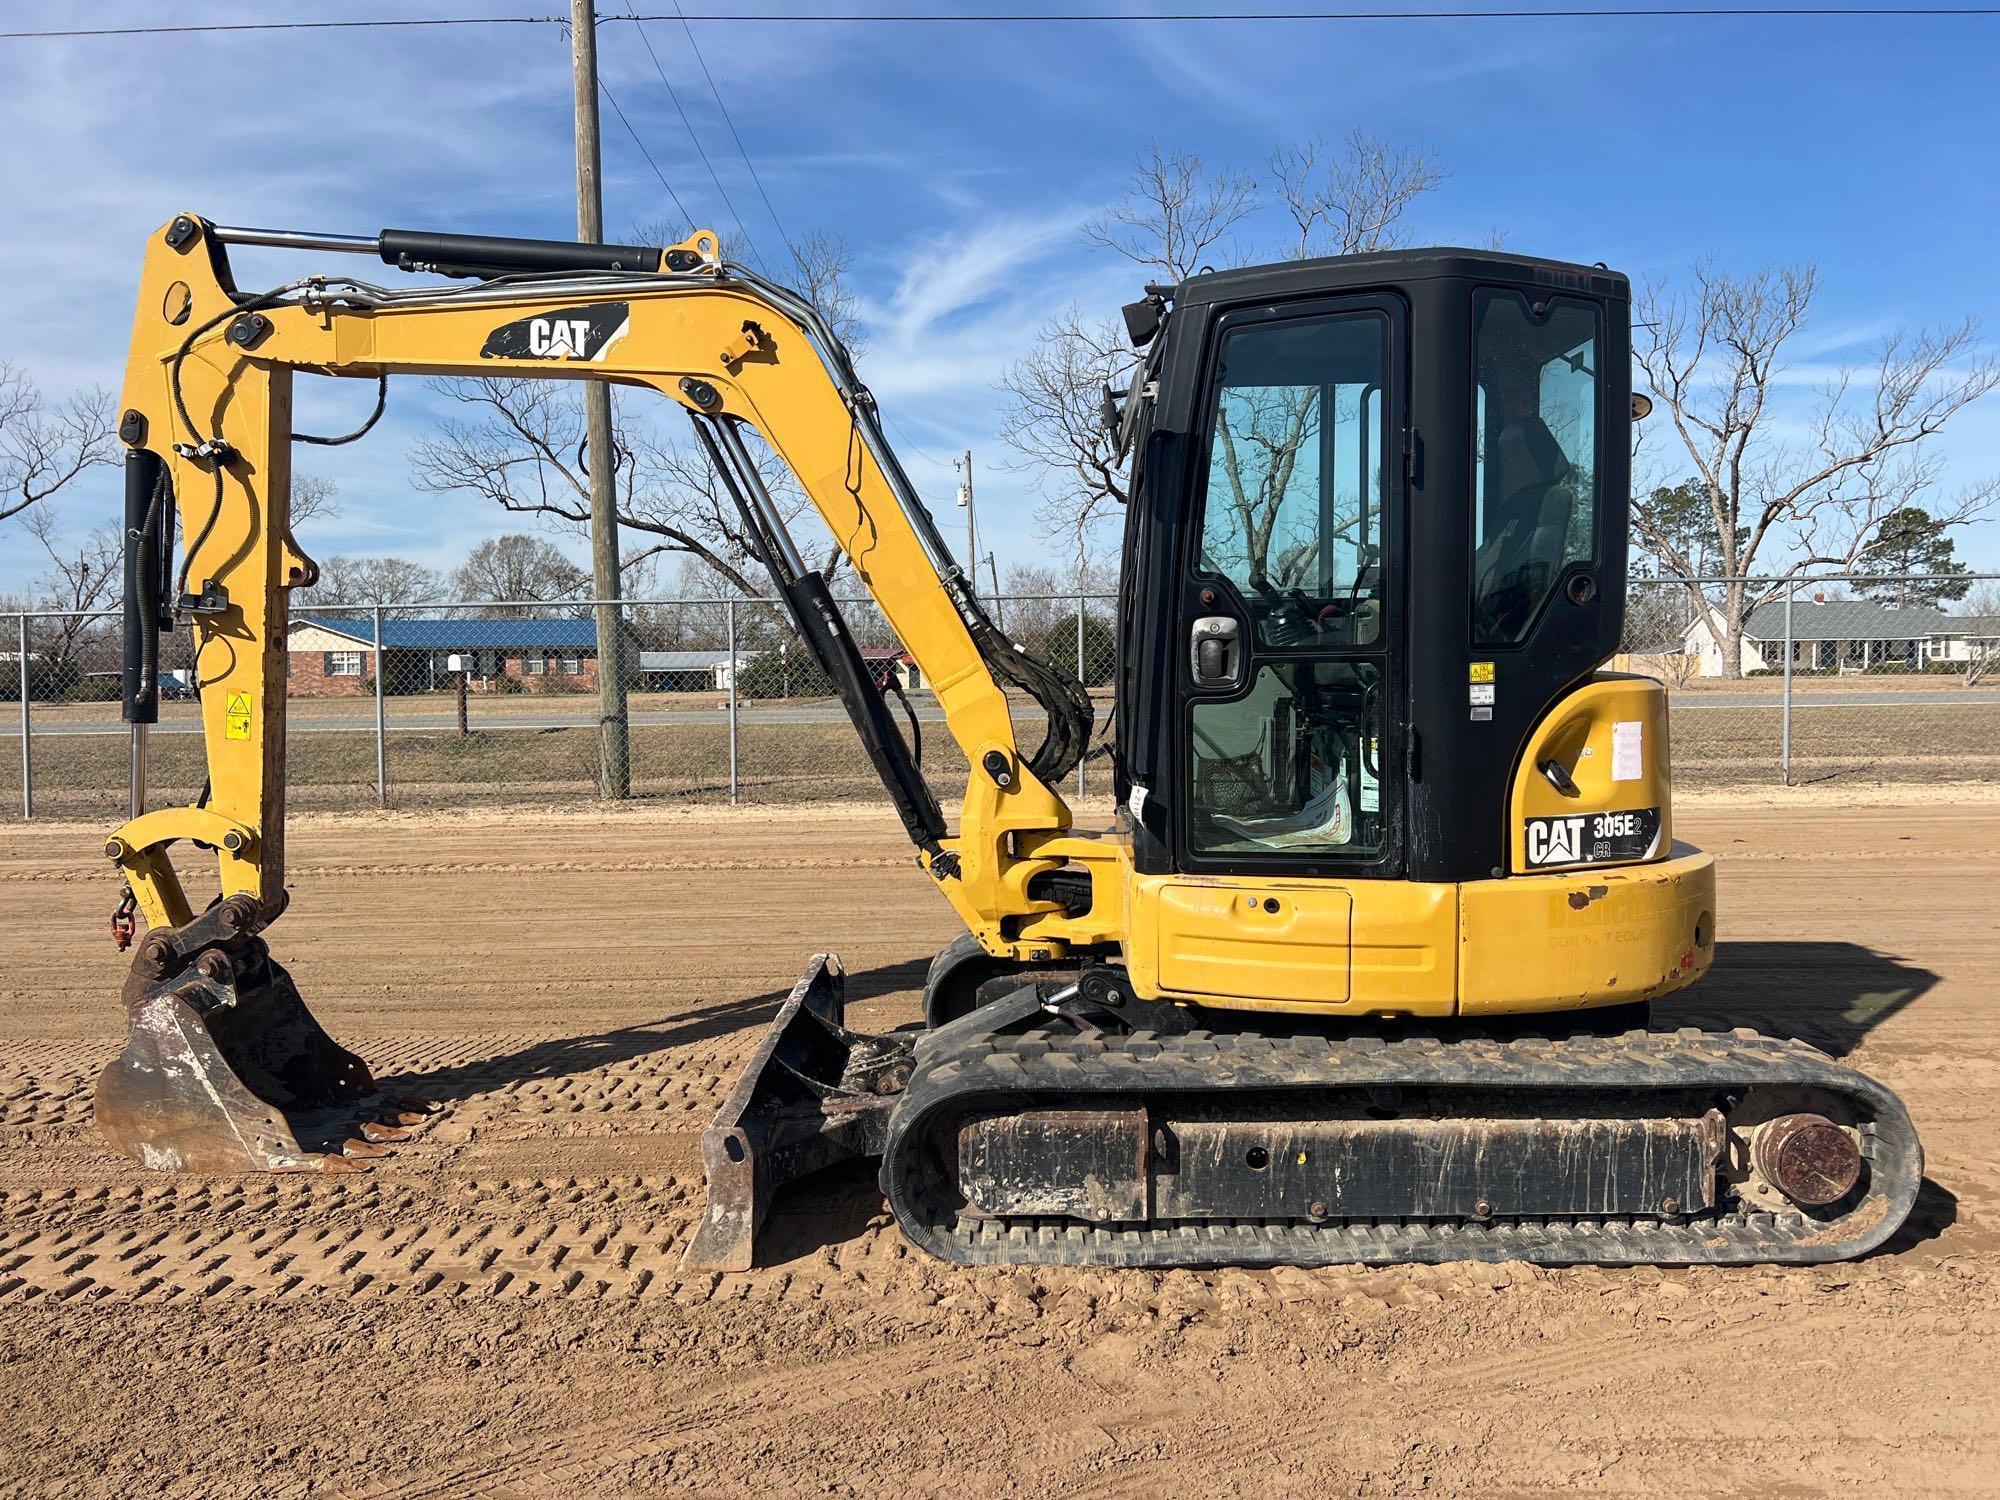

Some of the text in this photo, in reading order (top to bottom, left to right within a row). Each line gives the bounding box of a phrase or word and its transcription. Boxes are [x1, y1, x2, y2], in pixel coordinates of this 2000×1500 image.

[530, 319, 590, 357] CAT
[1528, 818, 1585, 864] CAT
[1593, 841, 1611, 859] CR
